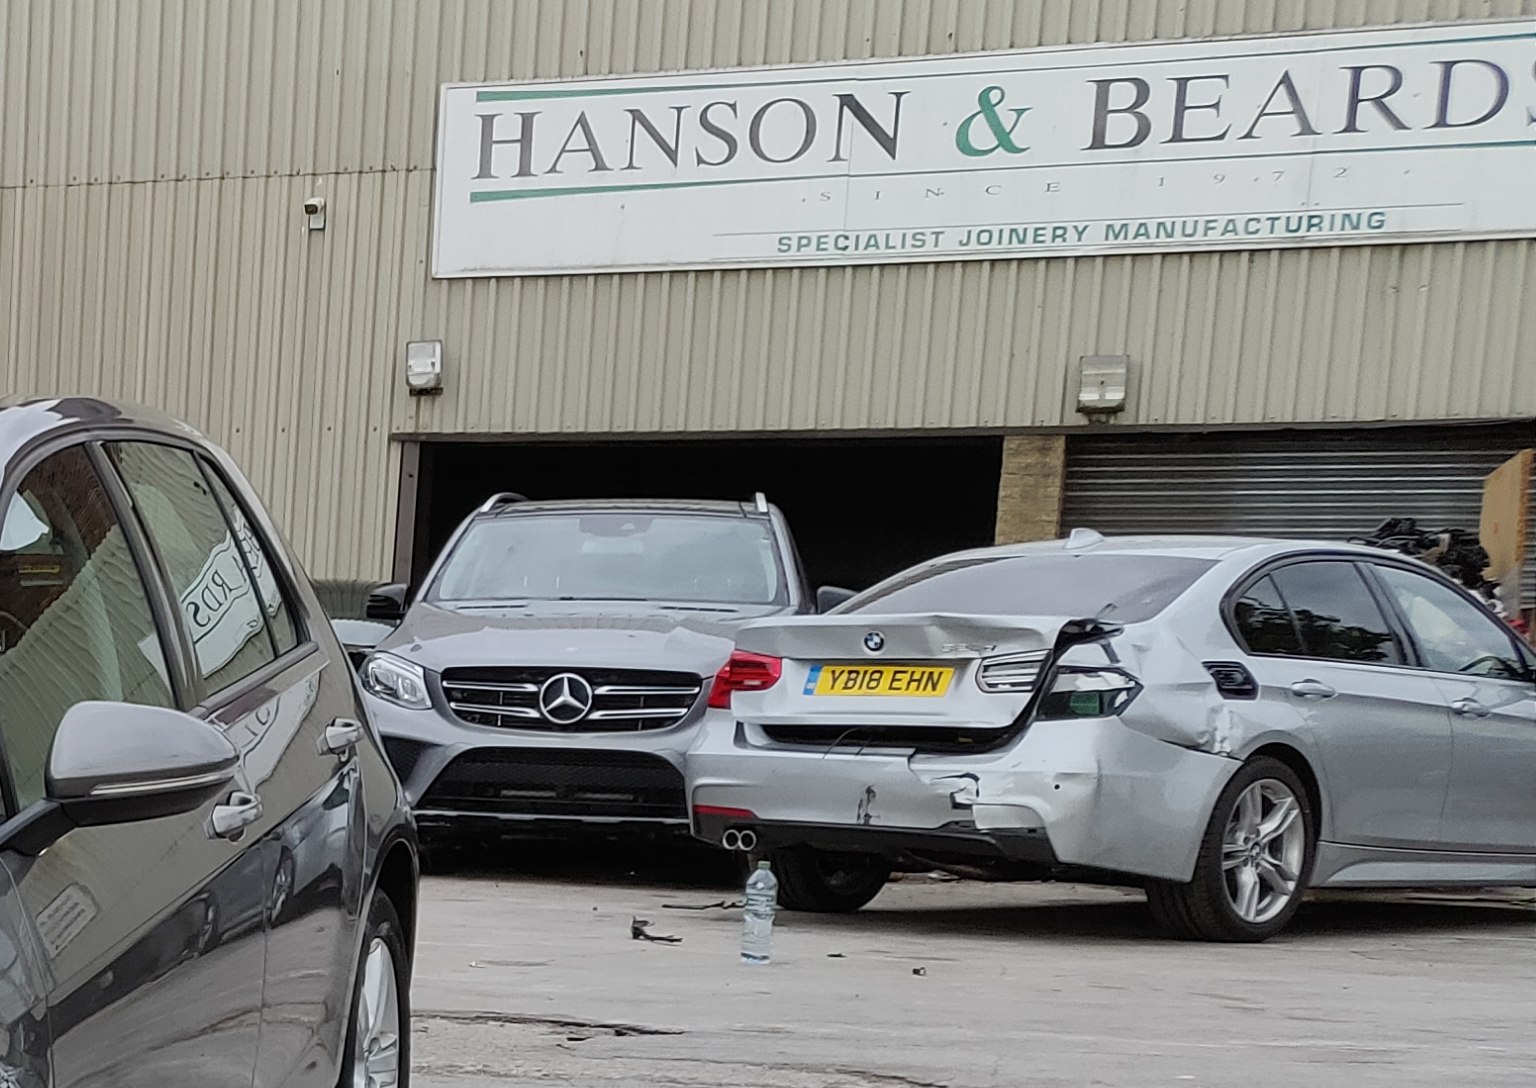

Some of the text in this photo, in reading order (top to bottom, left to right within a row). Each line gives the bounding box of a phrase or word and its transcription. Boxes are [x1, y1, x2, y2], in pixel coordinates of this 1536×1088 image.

[470, 57, 1536, 181] HANSON & BEARD
[818, 165, 1350, 203] SINCE 1972
[776, 210, 1388, 254] SPECIALIST JOINERY MANUFACTURING
[830, 669, 944, 692] YB18 EHN
